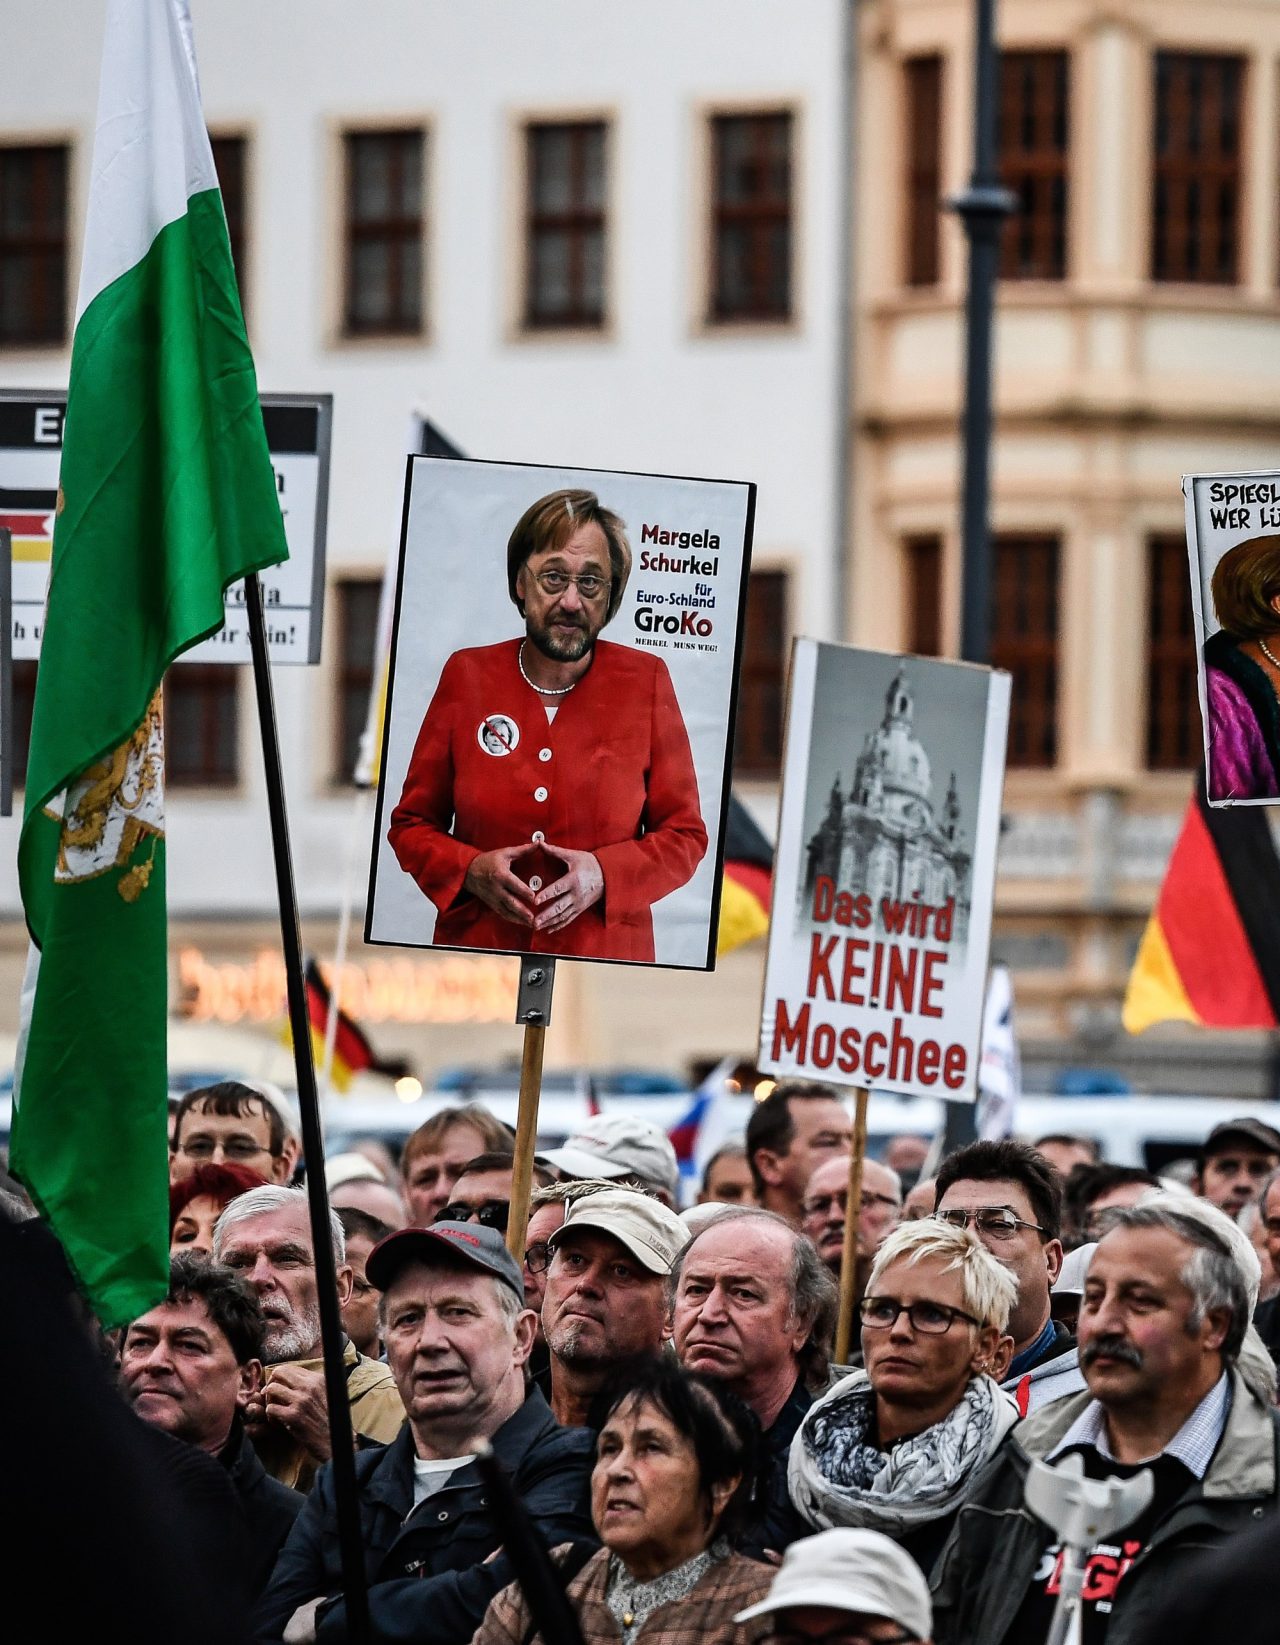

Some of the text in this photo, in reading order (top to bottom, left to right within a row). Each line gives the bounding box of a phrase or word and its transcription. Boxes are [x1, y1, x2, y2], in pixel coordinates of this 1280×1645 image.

[1210, 507, 1251, 529] WER
[641, 523, 720, 549] Margela
[640, 551, 718, 576] Schurkel
[637, 590, 715, 608] Euro-Schland
[695, 583, 712, 596] für
[634, 607, 713, 637] GroKo
[635, 637, 718, 652] MERKEL MUSS WEG!
[812, 875, 956, 943] Das wird
[807, 932, 949, 1018] KEINE
[771, 998, 967, 1089] Moschee
